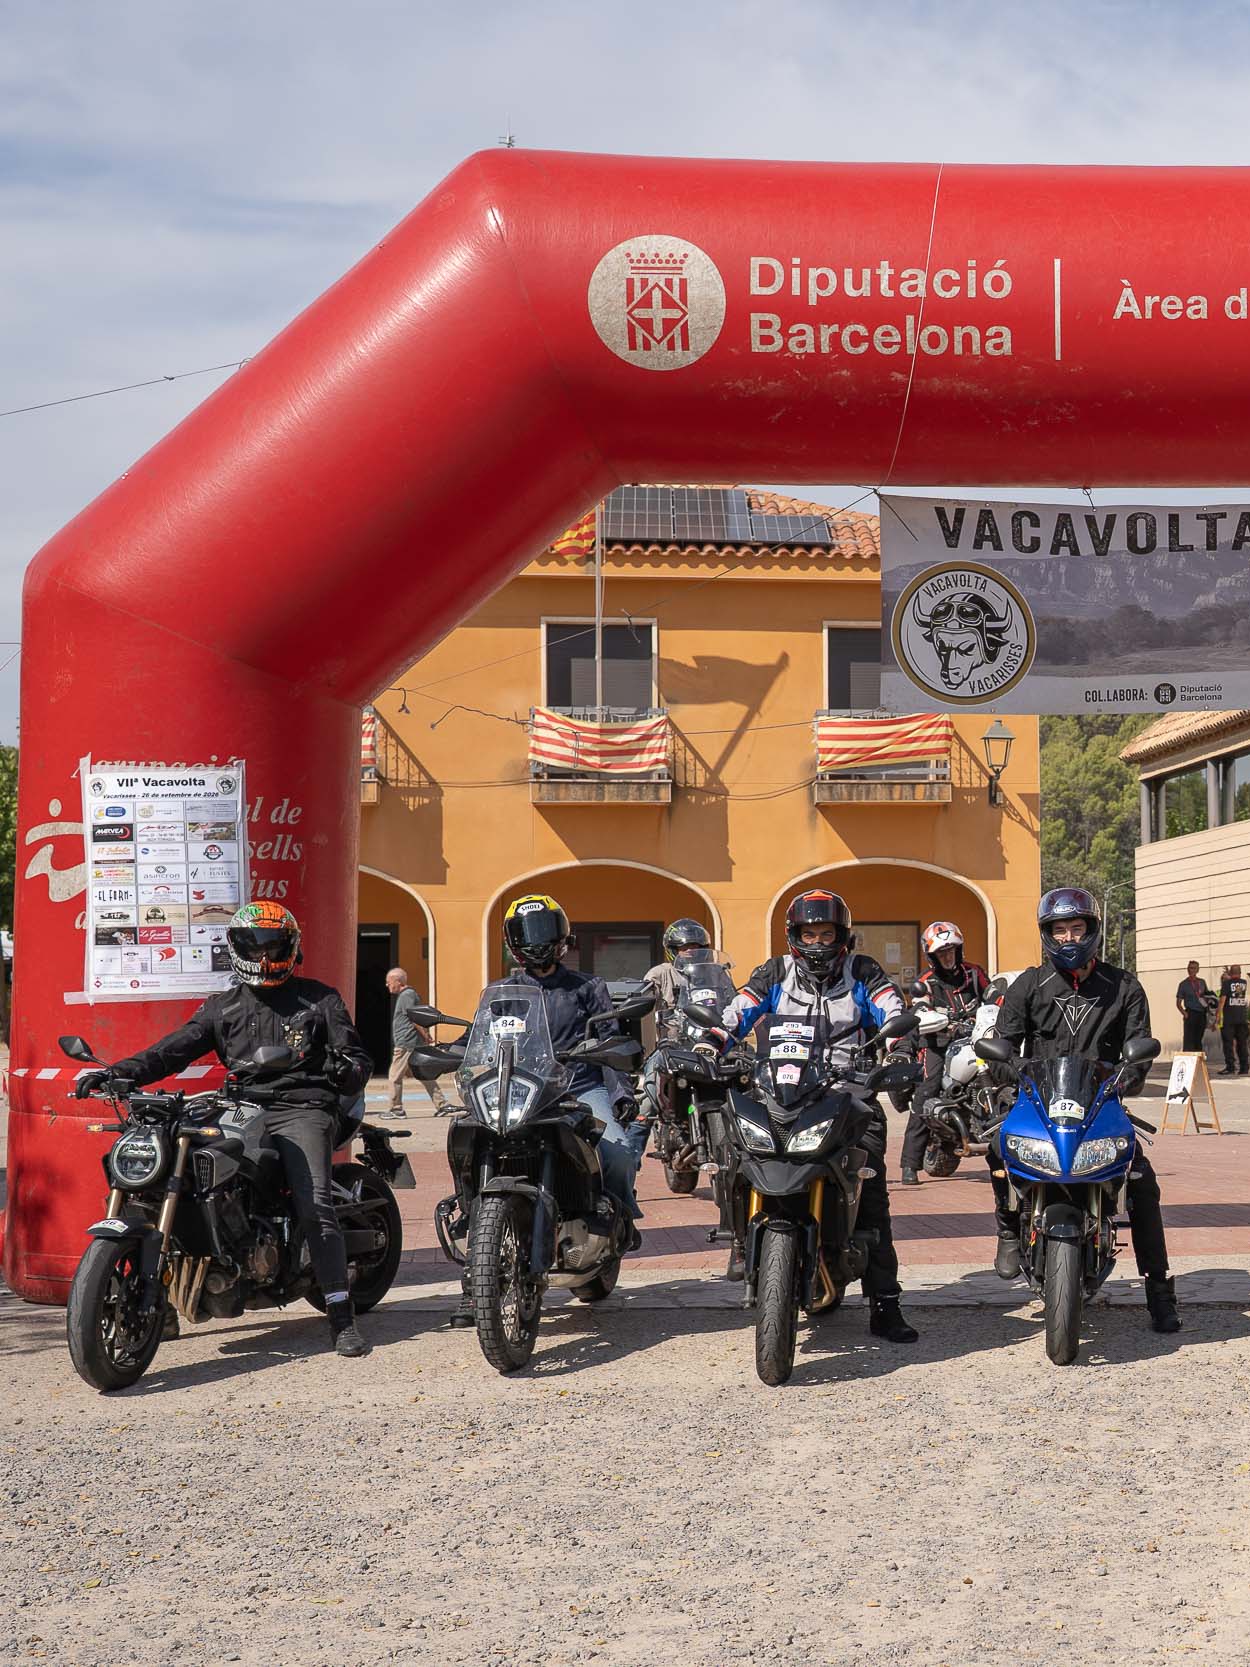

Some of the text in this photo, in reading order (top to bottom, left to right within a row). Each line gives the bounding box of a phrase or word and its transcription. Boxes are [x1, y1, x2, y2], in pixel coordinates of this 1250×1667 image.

[749, 256, 1013, 305] Diputació
[1113, 279, 1208, 320] Àrea
[750, 313, 1013, 356] Barcelona
[923, 574, 988, 599] VACAVOLTA
[969, 643, 1023, 695] VACARISSES
[1084, 688, 1149, 703] COL.LABORA:
[1180, 684, 1222, 693] Diputació
[1180, 693, 1222, 702] Barcelona
[142, 776, 206, 787] Vacavolta
[270, 798, 302, 824] de
[501, 1019, 515, 1027] 84
[783, 1045, 797, 1053] 88
[1060, 1102, 1074, 1111] 87
